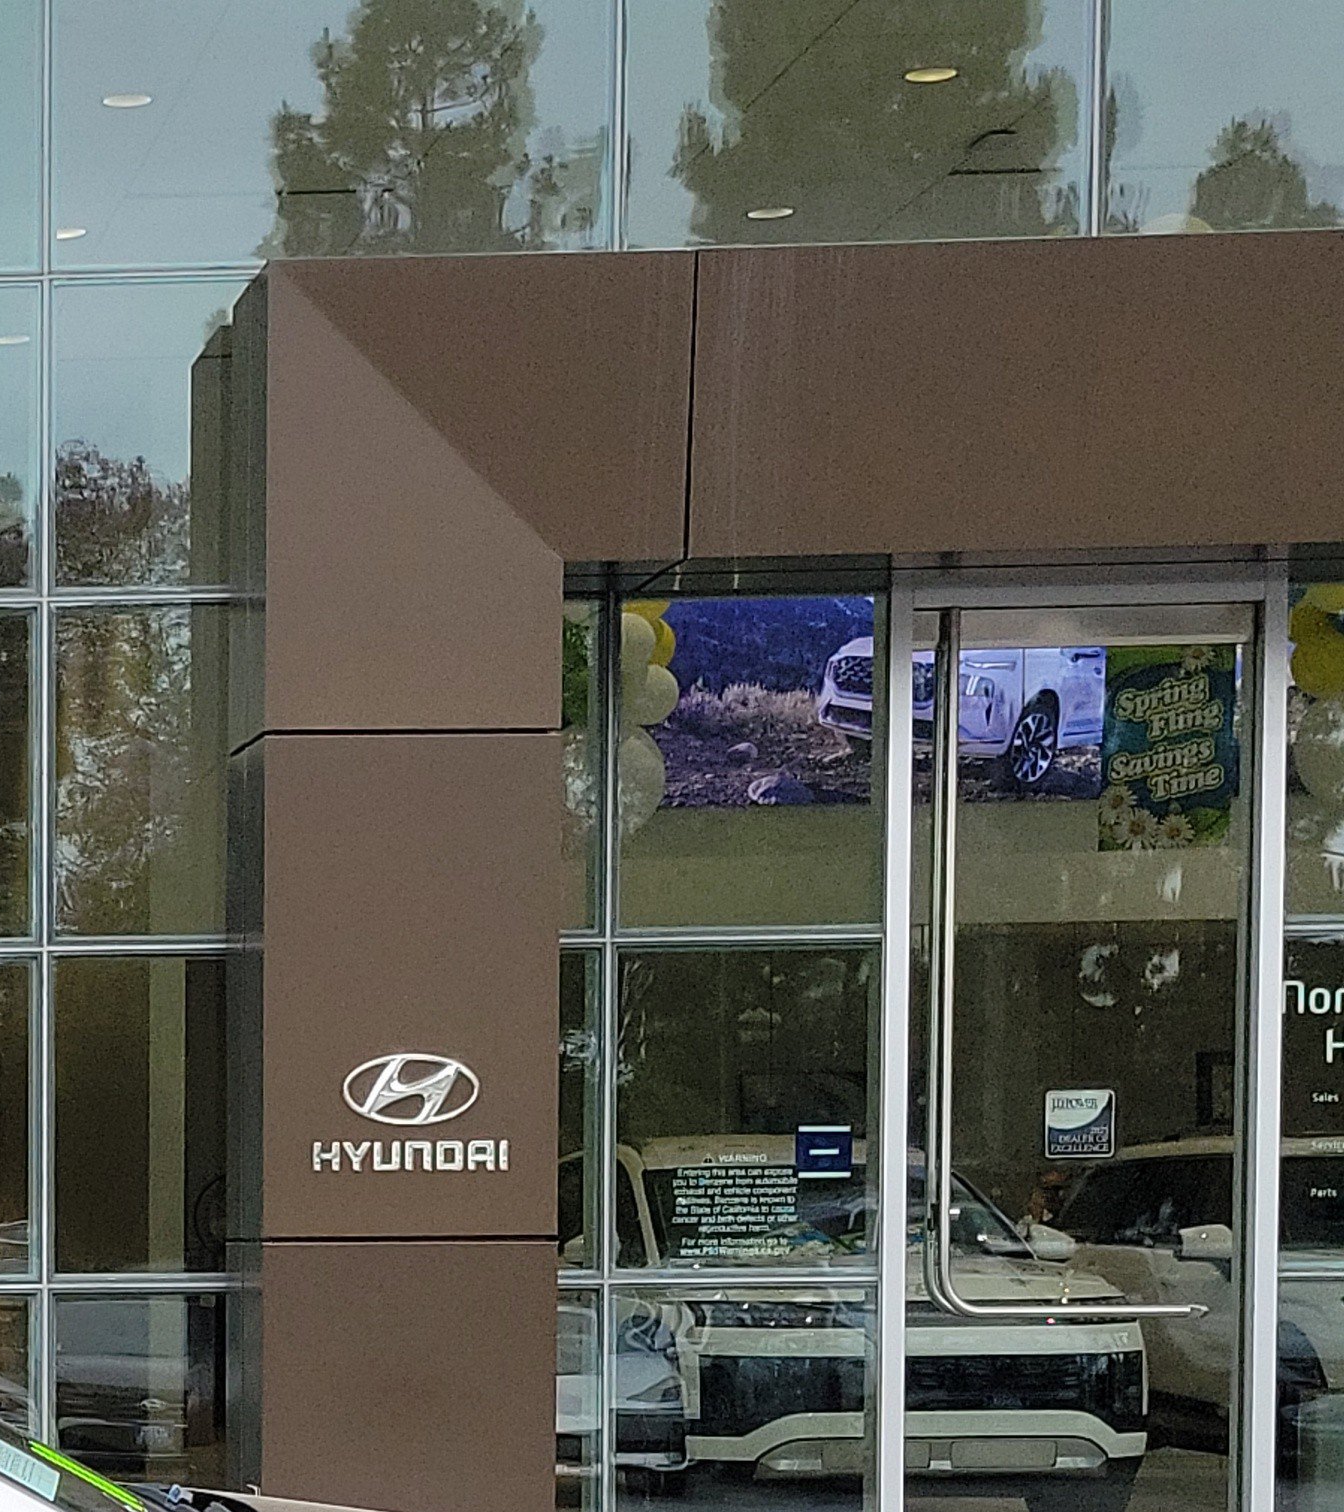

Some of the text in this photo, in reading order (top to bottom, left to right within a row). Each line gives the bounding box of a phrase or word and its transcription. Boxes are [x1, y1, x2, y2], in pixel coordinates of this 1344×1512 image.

[1117, 677, 1206, 718] Spring
[1150, 701, 1221, 738] Fling
[1112, 740, 1212, 780] Savings
[1150, 766, 1221, 799] Time
[1312, 1091, 1339, 1103] Sales
[313, 1139, 509, 1172] HYUNDAI
[1310, 1187, 1338, 1198] Parts
